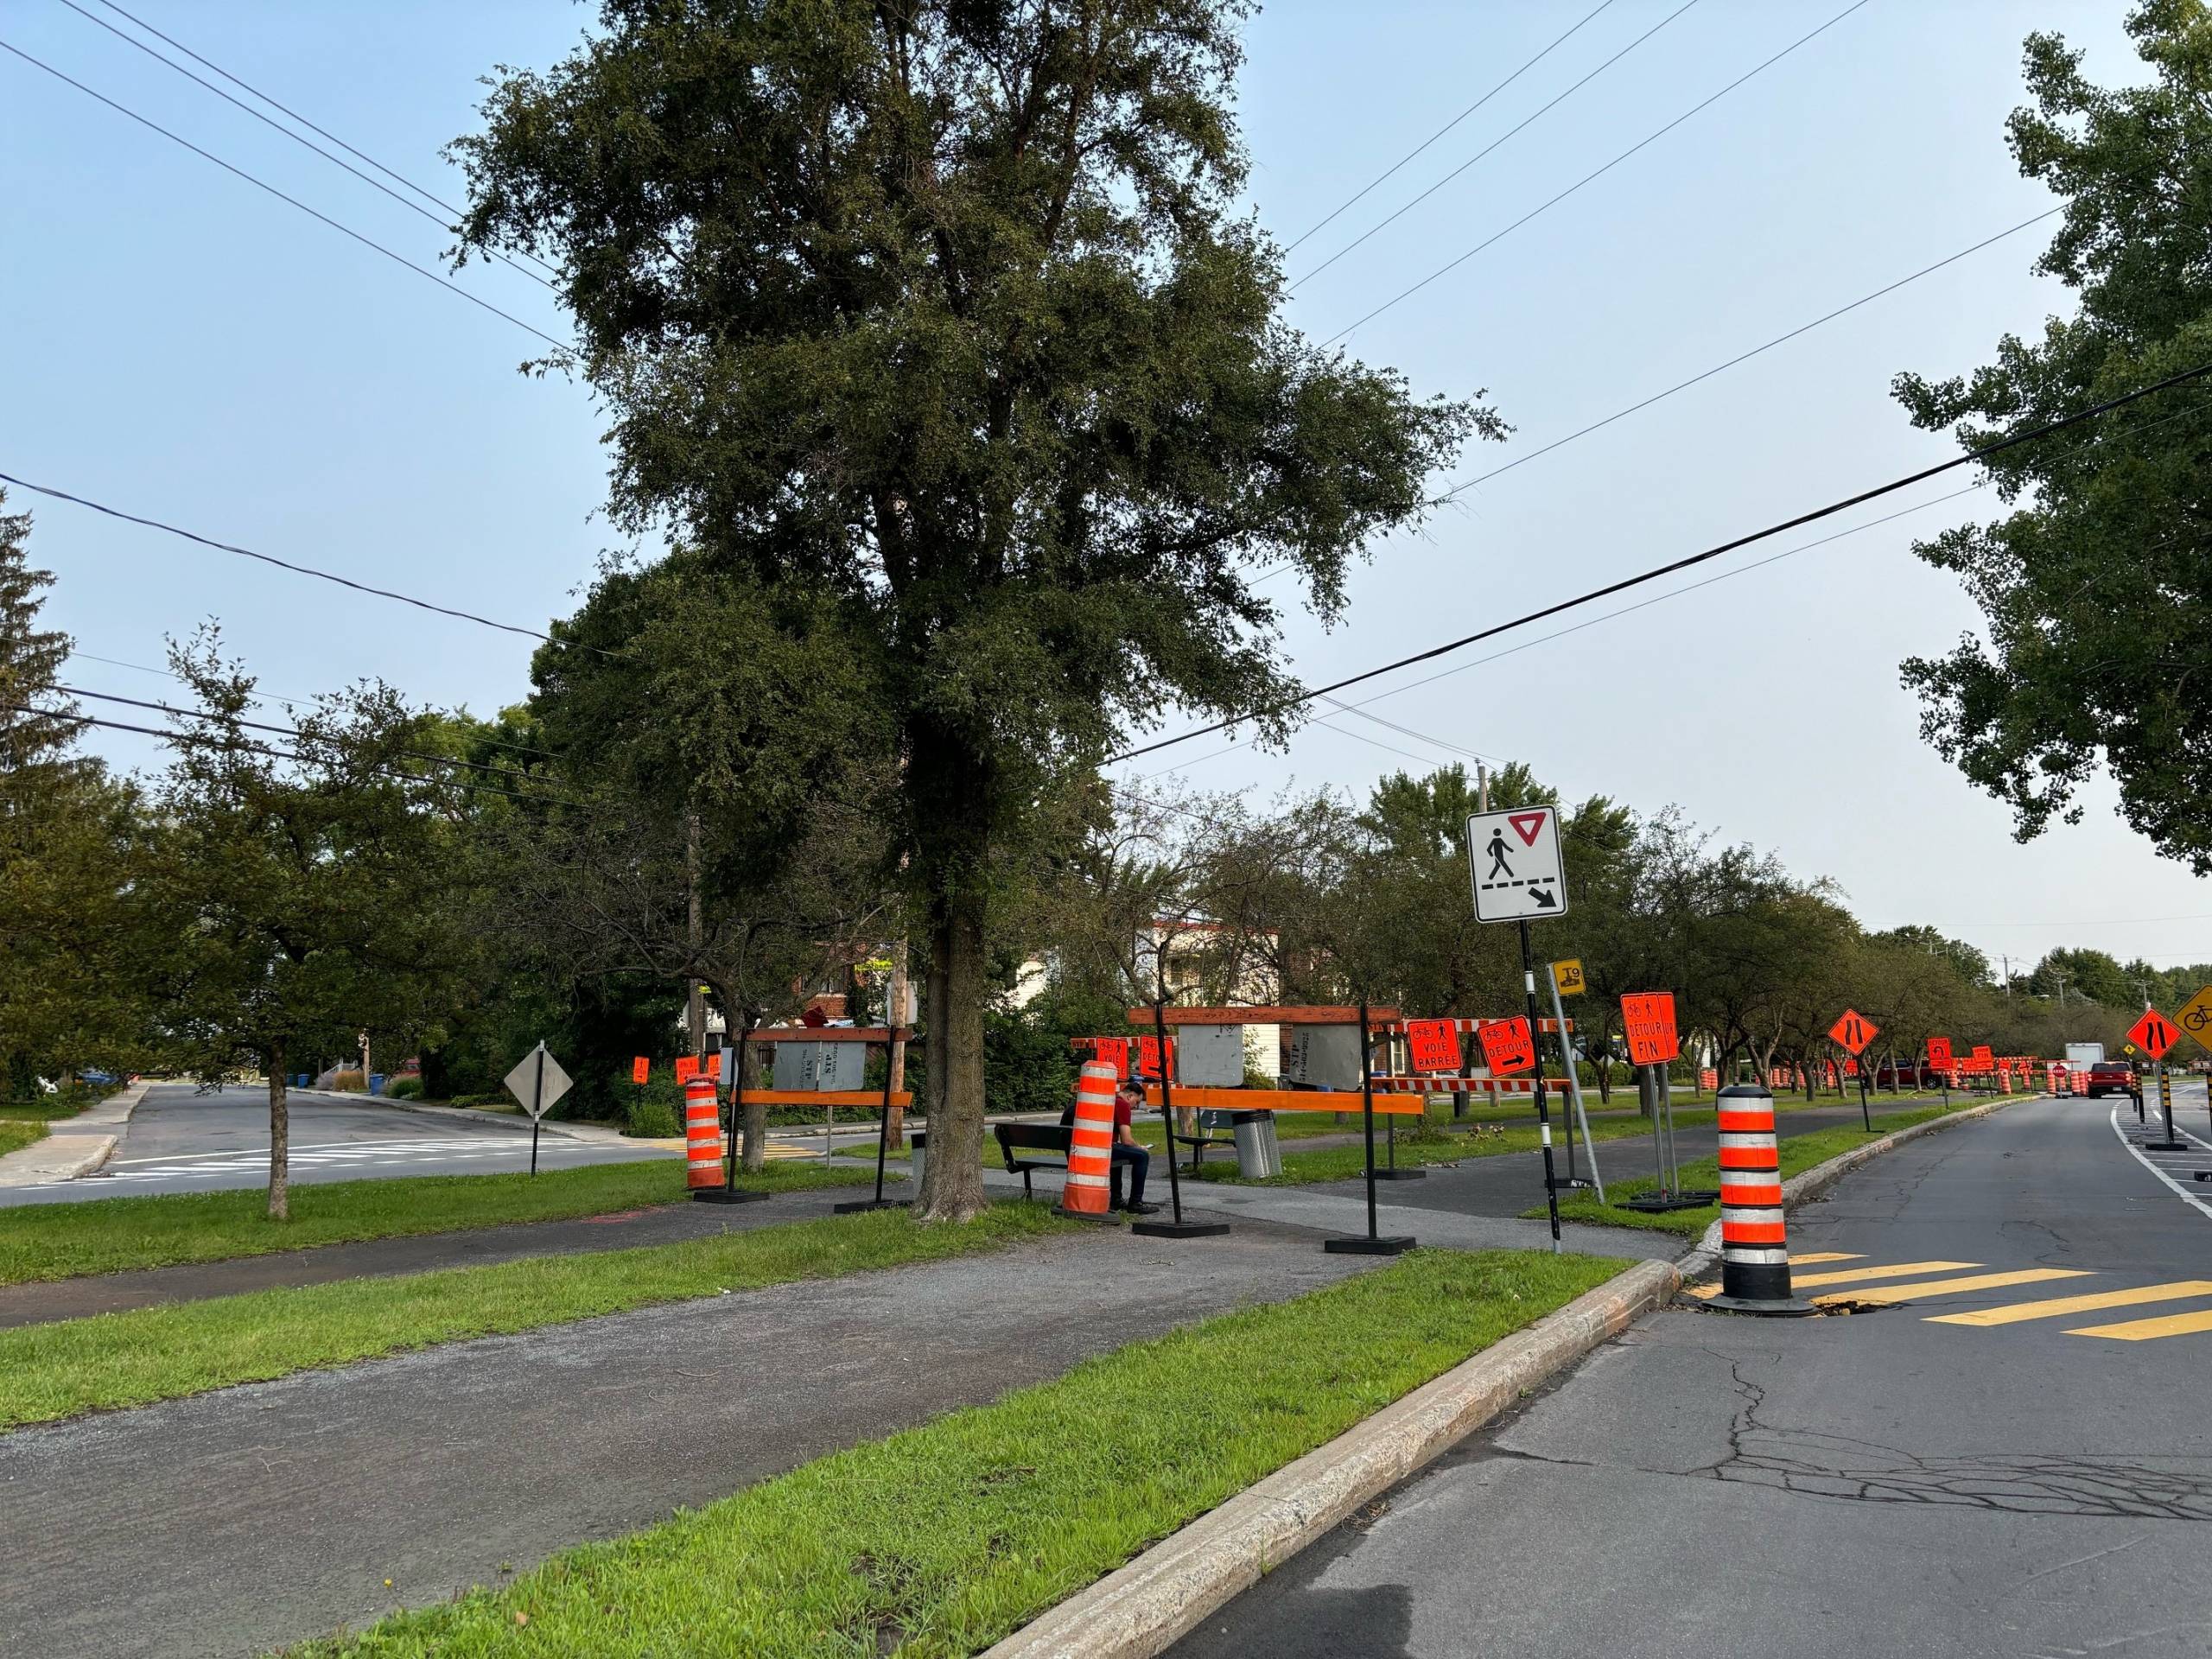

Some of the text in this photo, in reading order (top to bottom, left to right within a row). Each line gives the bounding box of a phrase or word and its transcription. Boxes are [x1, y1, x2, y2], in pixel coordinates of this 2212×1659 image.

[1572, 968, 1580, 977] 9
[1291, 1044, 1300, 1067] STP
[1424, 1043, 1448, 1053] VOIE
[1638, 1040, 1658, 1058] FIN
[1419, 1053, 1458, 1068] BARRÉE
